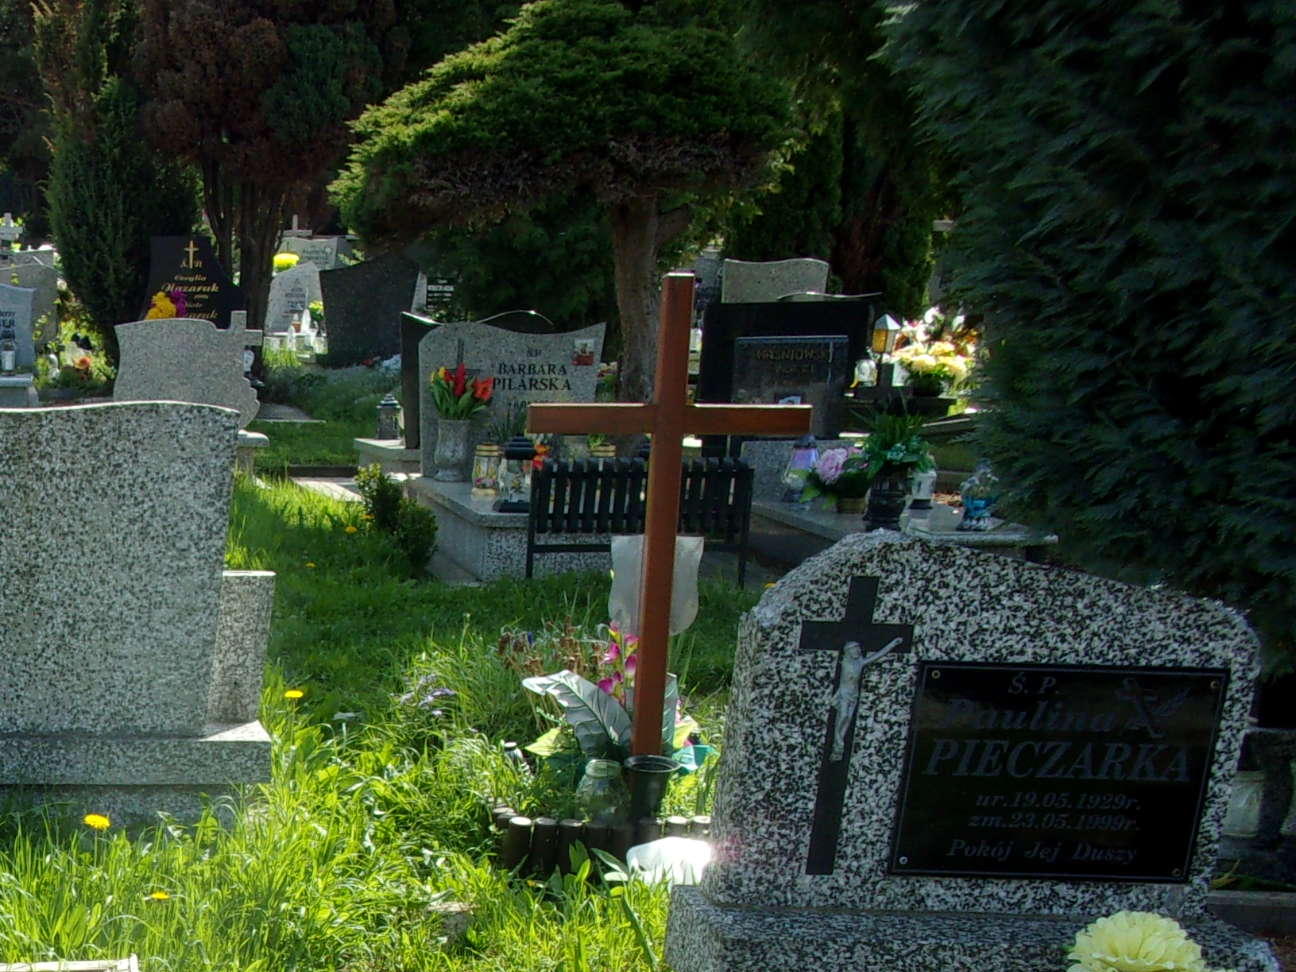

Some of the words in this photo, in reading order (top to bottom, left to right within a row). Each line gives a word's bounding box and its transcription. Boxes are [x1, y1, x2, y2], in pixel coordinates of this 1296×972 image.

[498, 362, 568, 375] BARBARA
[493, 377, 572, 391] PILARSKA
[942, 698, 1114, 732] Paulina
[921, 738, 1191, 782] PIECZARKA
[1024, 841, 1062, 863] Jej
